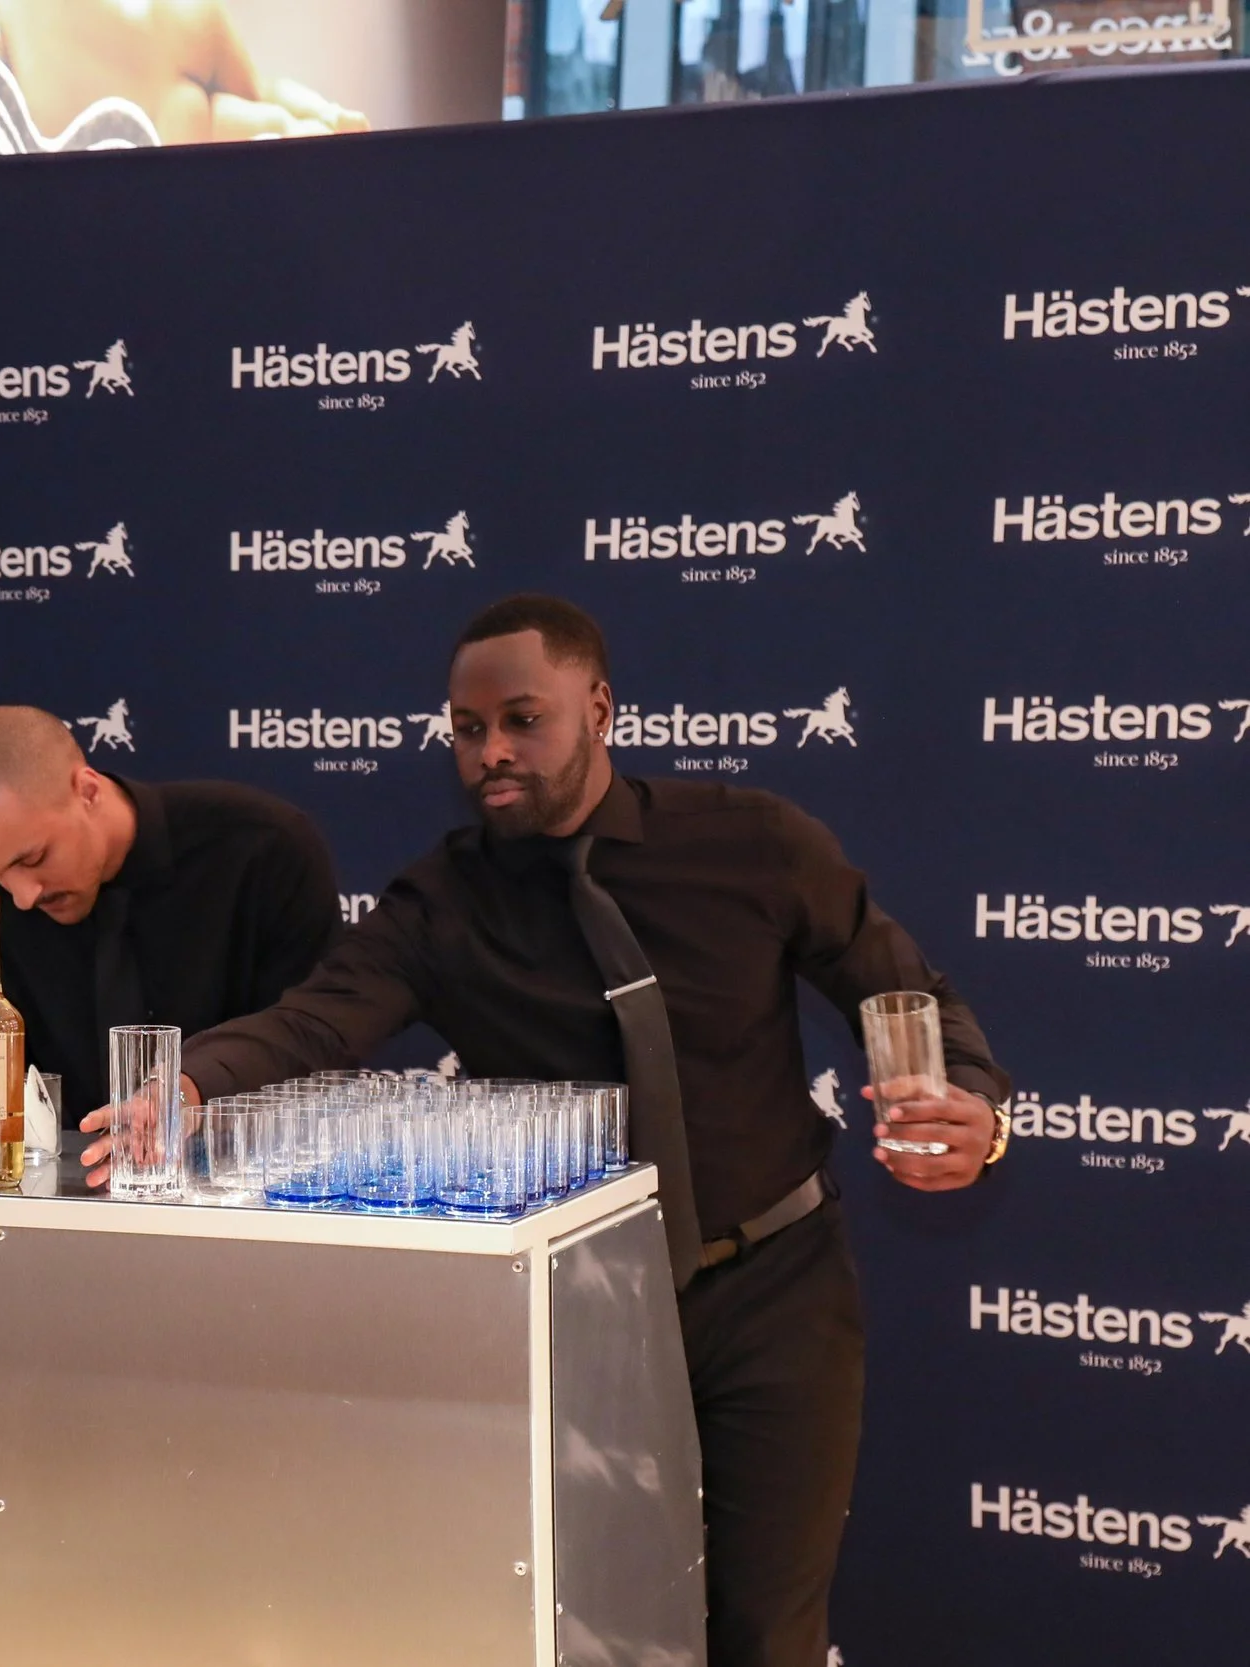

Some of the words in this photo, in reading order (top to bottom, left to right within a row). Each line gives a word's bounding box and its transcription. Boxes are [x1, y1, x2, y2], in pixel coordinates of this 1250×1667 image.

[1004, 287, 1230, 341] Hästens
[593, 319, 796, 370] Hästens
[1113, 343, 1159, 361] since
[1163, 340, 1198, 361] 1852
[232, 343, 411, 388] Hästens
[690, 373, 732, 389] since
[735, 370, 767, 390] 1852
[318, 395, 354, 410] since
[357, 393, 385, 411] 1852
[23, 408, 48, 425] 1852
[993, 492, 1221, 542] Hästens
[231, 529, 406, 571] Hästens
[585, 515, 786, 560] Hästens
[1103, 548, 1149, 566] since
[1154, 546, 1189, 567] 1852
[315, 579, 351, 593] since
[353, 578, 381, 596] 1852
[681, 567, 722, 583] since
[725, 565, 757, 584] 1852
[25, 587, 50, 603] 1852
[230, 709, 402, 748] Hästens
[983, 695, 1211, 741] Hästens
[313, 758, 349, 771] since
[351, 757, 378, 775] 1852
[674, 756, 714, 771] since
[717, 755, 749, 774] 1852
[1093, 751, 1139, 767] since
[1144, 750, 1179, 771] 1852
[976, 894, 1203, 943] Hästens
[1086, 951, 1131, 968] since
[1136, 952, 1171, 973] 1852
[999, 1092, 1197, 1146] ästens
[1081, 1151, 1126, 1169] since
[1130, 1154, 1166, 1174] 1852
[971, 1286, 1194, 1348] Hästens
[1079, 1351, 1124, 1369] since
[1128, 1355, 1163, 1376] 1852
[972, 1484, 1192, 1551] Hästens
[1079, 1553, 1124, 1571] since
[1128, 1558, 1162, 1578] 1852
